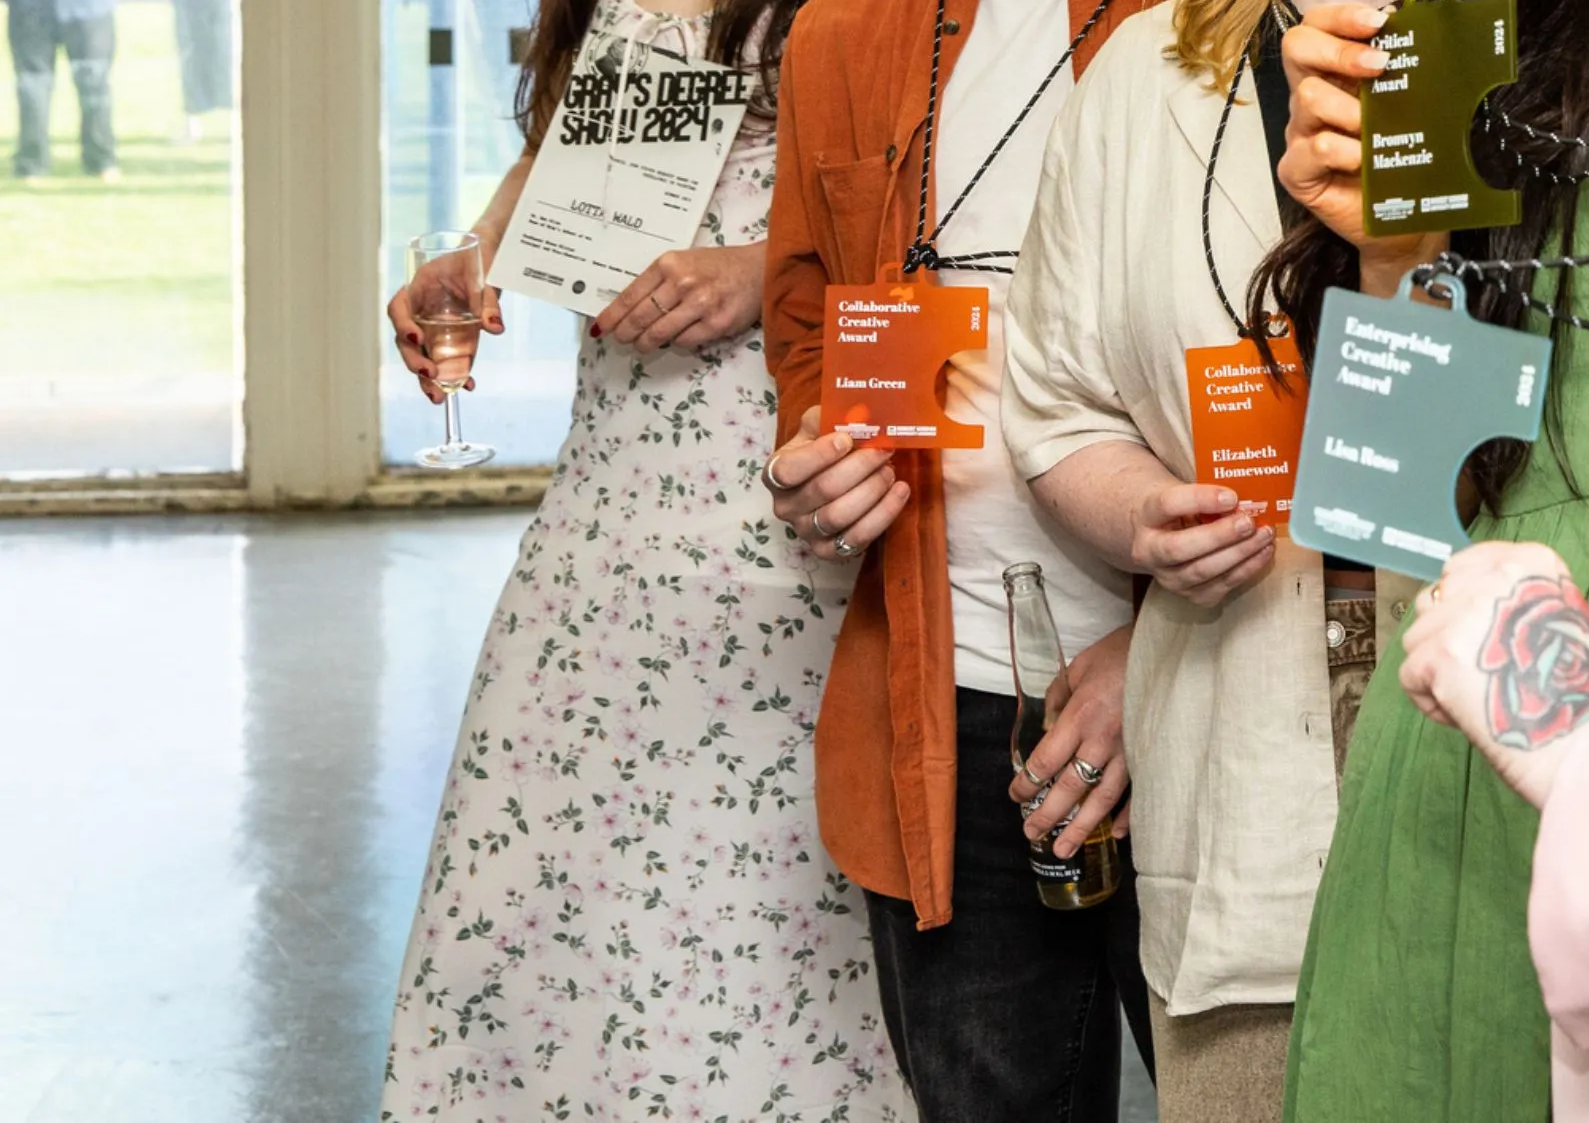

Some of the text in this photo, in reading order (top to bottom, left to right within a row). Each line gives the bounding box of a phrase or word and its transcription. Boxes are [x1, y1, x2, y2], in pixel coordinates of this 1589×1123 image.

[1386, 53, 1419, 70] eative
[657, 70, 750, 107] DEGREE
[1371, 74, 1408, 93] Award
[560, 105, 711, 146] SHOW 2024
[612, 211, 643, 229] WALD
[838, 301, 920, 313] Collaborative
[838, 316, 890, 328] Creative
[837, 331, 878, 343] Award
[1344, 316, 1452, 365] Enterprising
[1340, 341, 1412, 375] Creative
[836, 378, 906, 389] Liam Green
[1206, 381, 1264, 396] Creative
[1336, 365, 1392, 395] Award
[1208, 398, 1252, 413] Award
[1212, 446, 1277, 462] Elizabeth
[1214, 462, 1289, 479] Homewood
